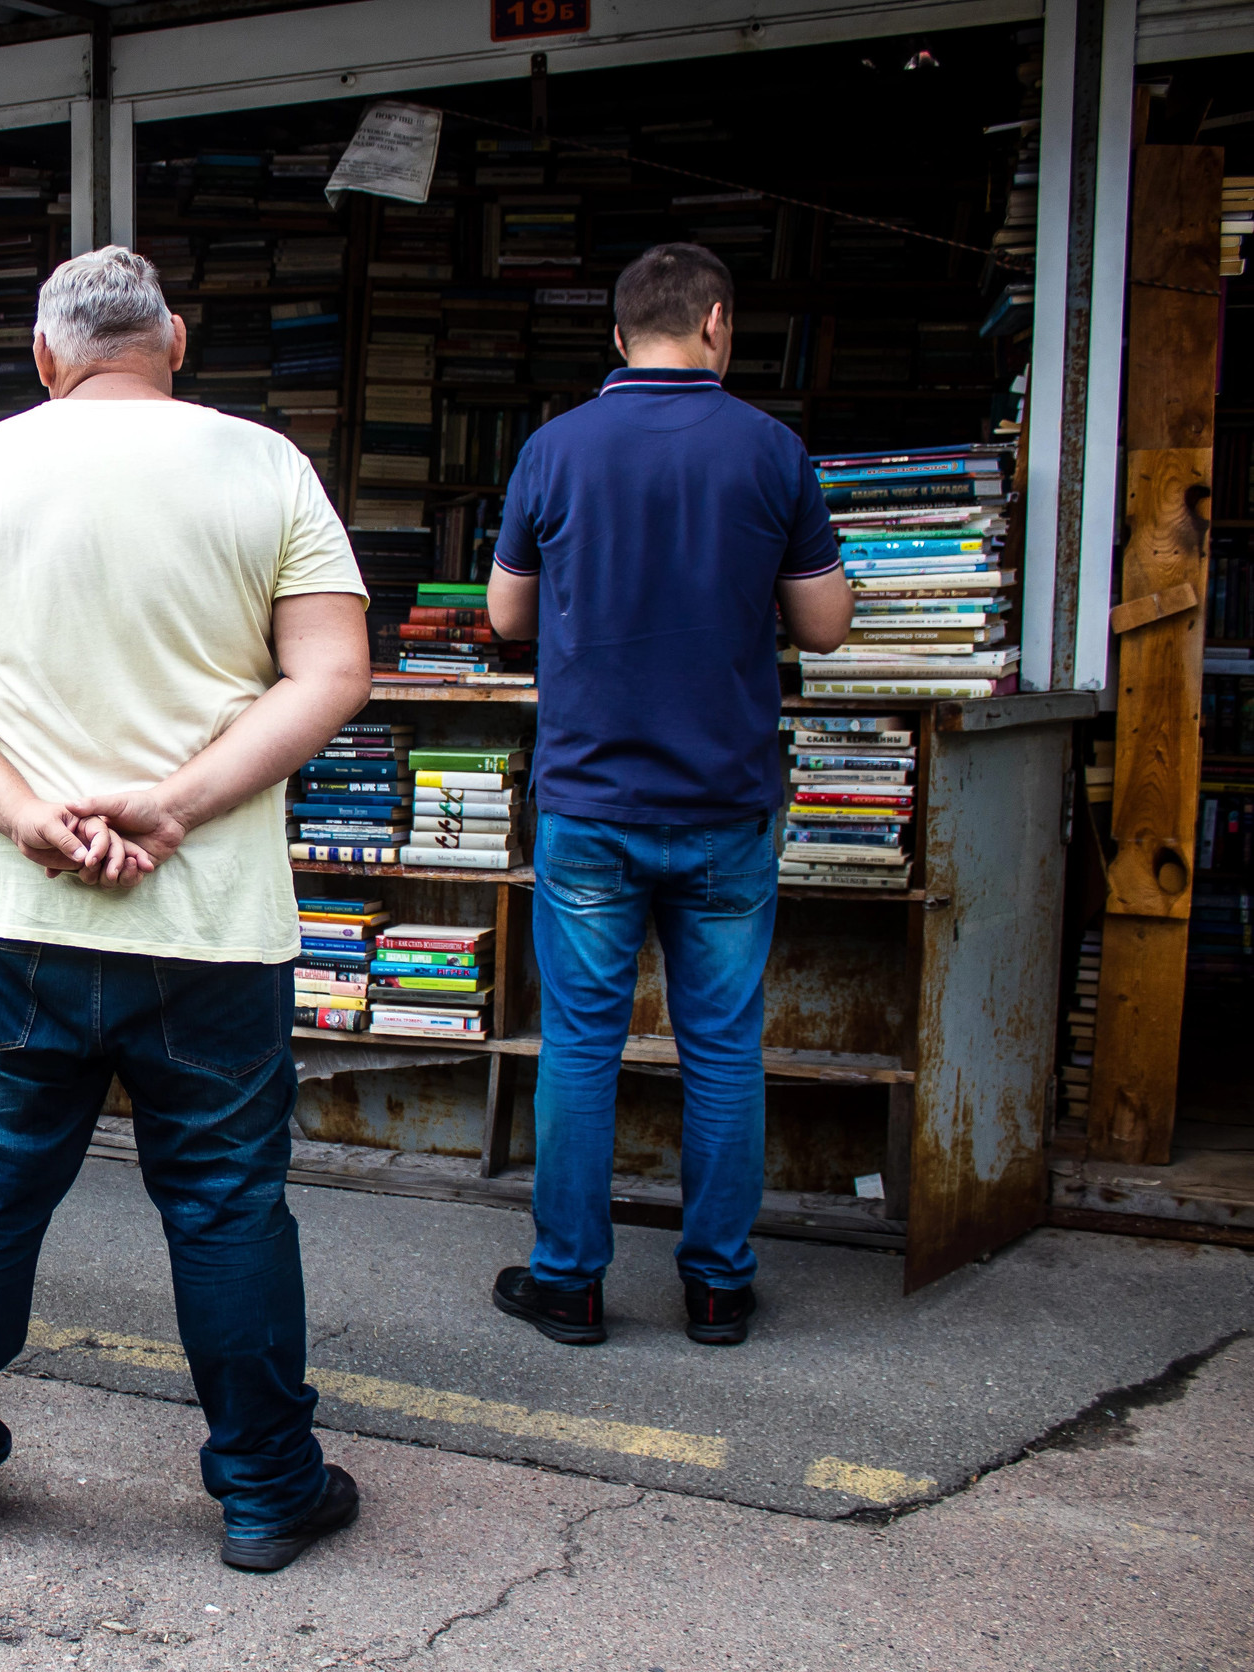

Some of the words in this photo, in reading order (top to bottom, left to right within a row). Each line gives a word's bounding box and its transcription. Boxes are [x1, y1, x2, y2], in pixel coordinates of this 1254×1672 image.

[851, 489, 888, 499] ПЛАНЕТА
[892, 487, 918, 498] ЧУДЕС
[920, 487, 927, 496] И
[931, 484, 970, 495] ЗАГАДОК
[864, 632, 913, 640] Сокровищница
[806, 735, 842, 743] СКАЗКИ
